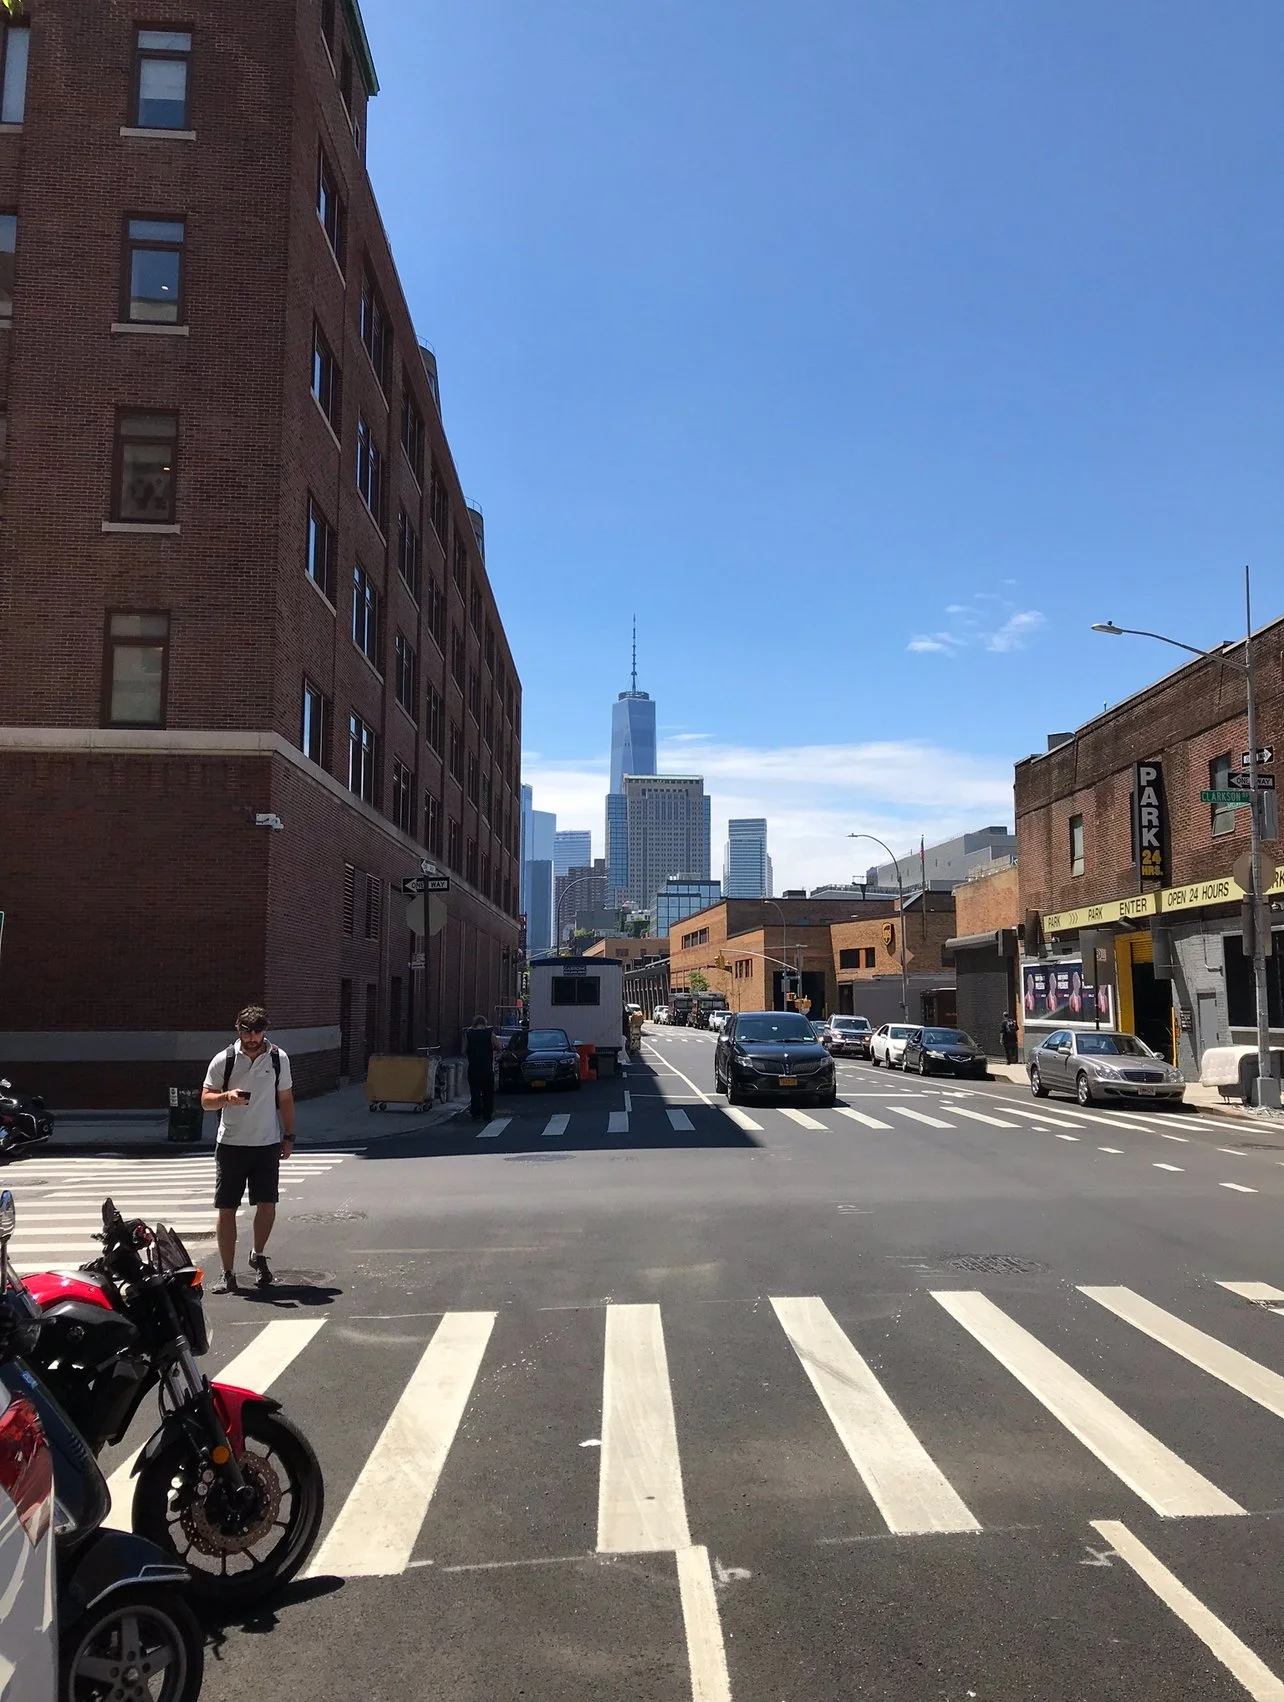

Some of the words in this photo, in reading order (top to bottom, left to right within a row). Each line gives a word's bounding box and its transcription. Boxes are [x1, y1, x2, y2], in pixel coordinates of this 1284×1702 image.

[1140, 767, 1160, 846] PARK
[1202, 792, 1240, 802] CLARKSON
[1142, 850, 1162, 864] 24
[1168, 891, 1187, 906] OPEN
[1189, 888, 1198, 902] 24
[1202, 882, 1229, 900] HOURS
[1048, 916, 1060, 929] PARK
[1088, 907, 1103, 921] PARK
[1120, 898, 1147, 916] ENTER
